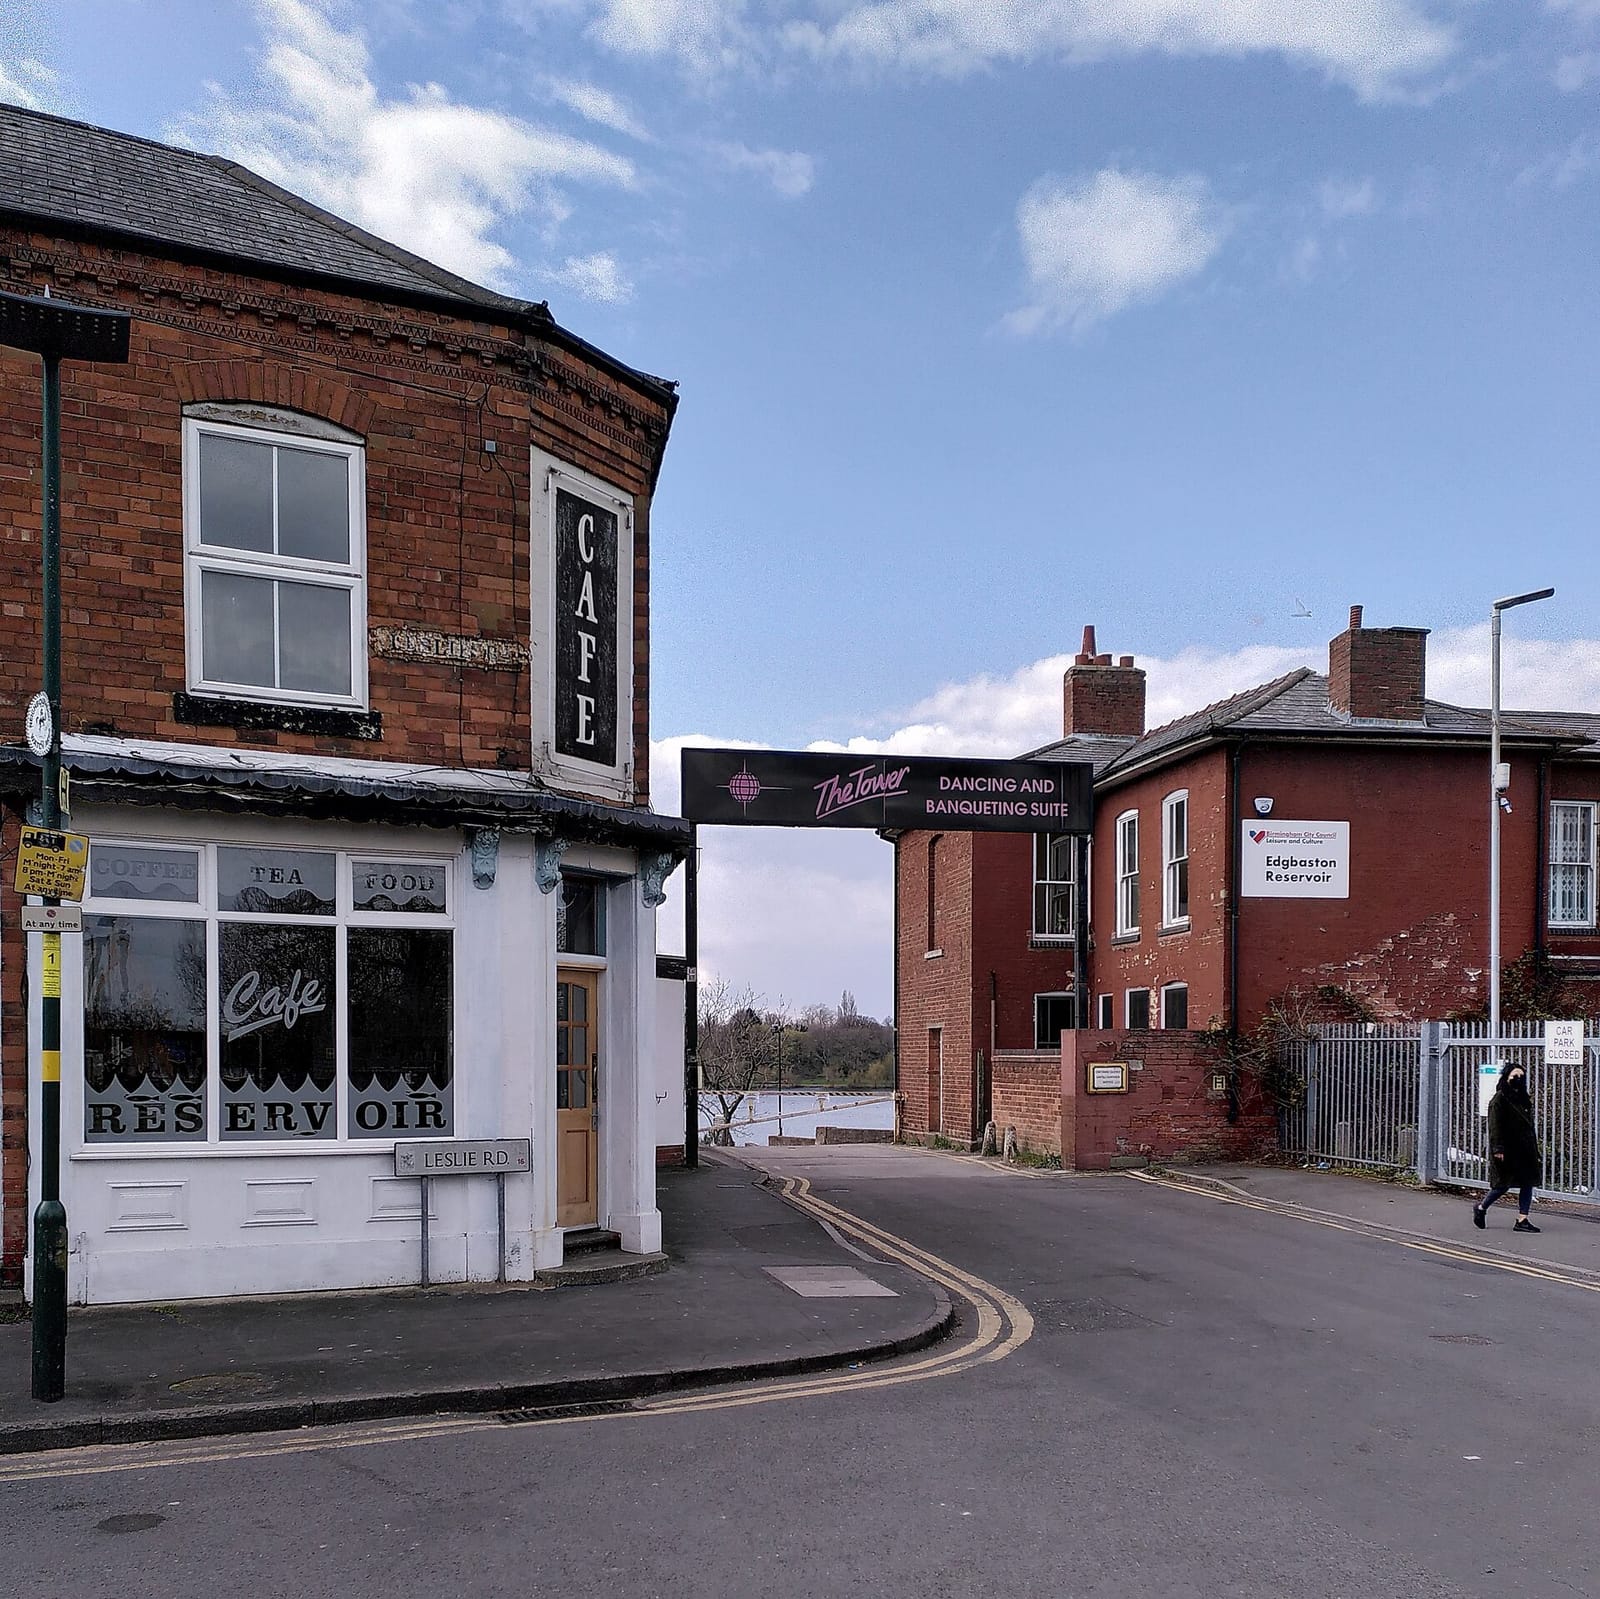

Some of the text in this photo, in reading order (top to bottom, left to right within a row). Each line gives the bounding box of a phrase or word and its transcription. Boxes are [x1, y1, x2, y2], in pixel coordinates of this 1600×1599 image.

[575, 513, 599, 747] CAFE
[813, 765, 912, 815] The Tower
[939, 776, 1055, 794] DANCING AND
[926, 799, 1069, 817] BANQUETING SUITE
[1266, 830, 1303, 839] Birmingham
[94, 858, 196, 879] COFFEE
[1266, 856, 1337, 870] Edgbaston
[29, 875, 44, 884] Sat
[54, 880, 71, 888] Sun
[253, 867, 304, 885] TEA
[365, 873, 434, 891] FOOD
[1266, 871, 1332, 883] Reservoir
[24, 883, 36, 891] At
[39, 922, 55, 931] any
[48, 953, 55, 964] 1
[223, 969, 321, 1029] Cafe
[1556, 1026, 1573, 1036] CAR
[1554, 1038, 1575, 1047] PARK
[1548, 1050, 1580, 1060] CLOSED
[424, 1152, 477, 1168] LESLIE
